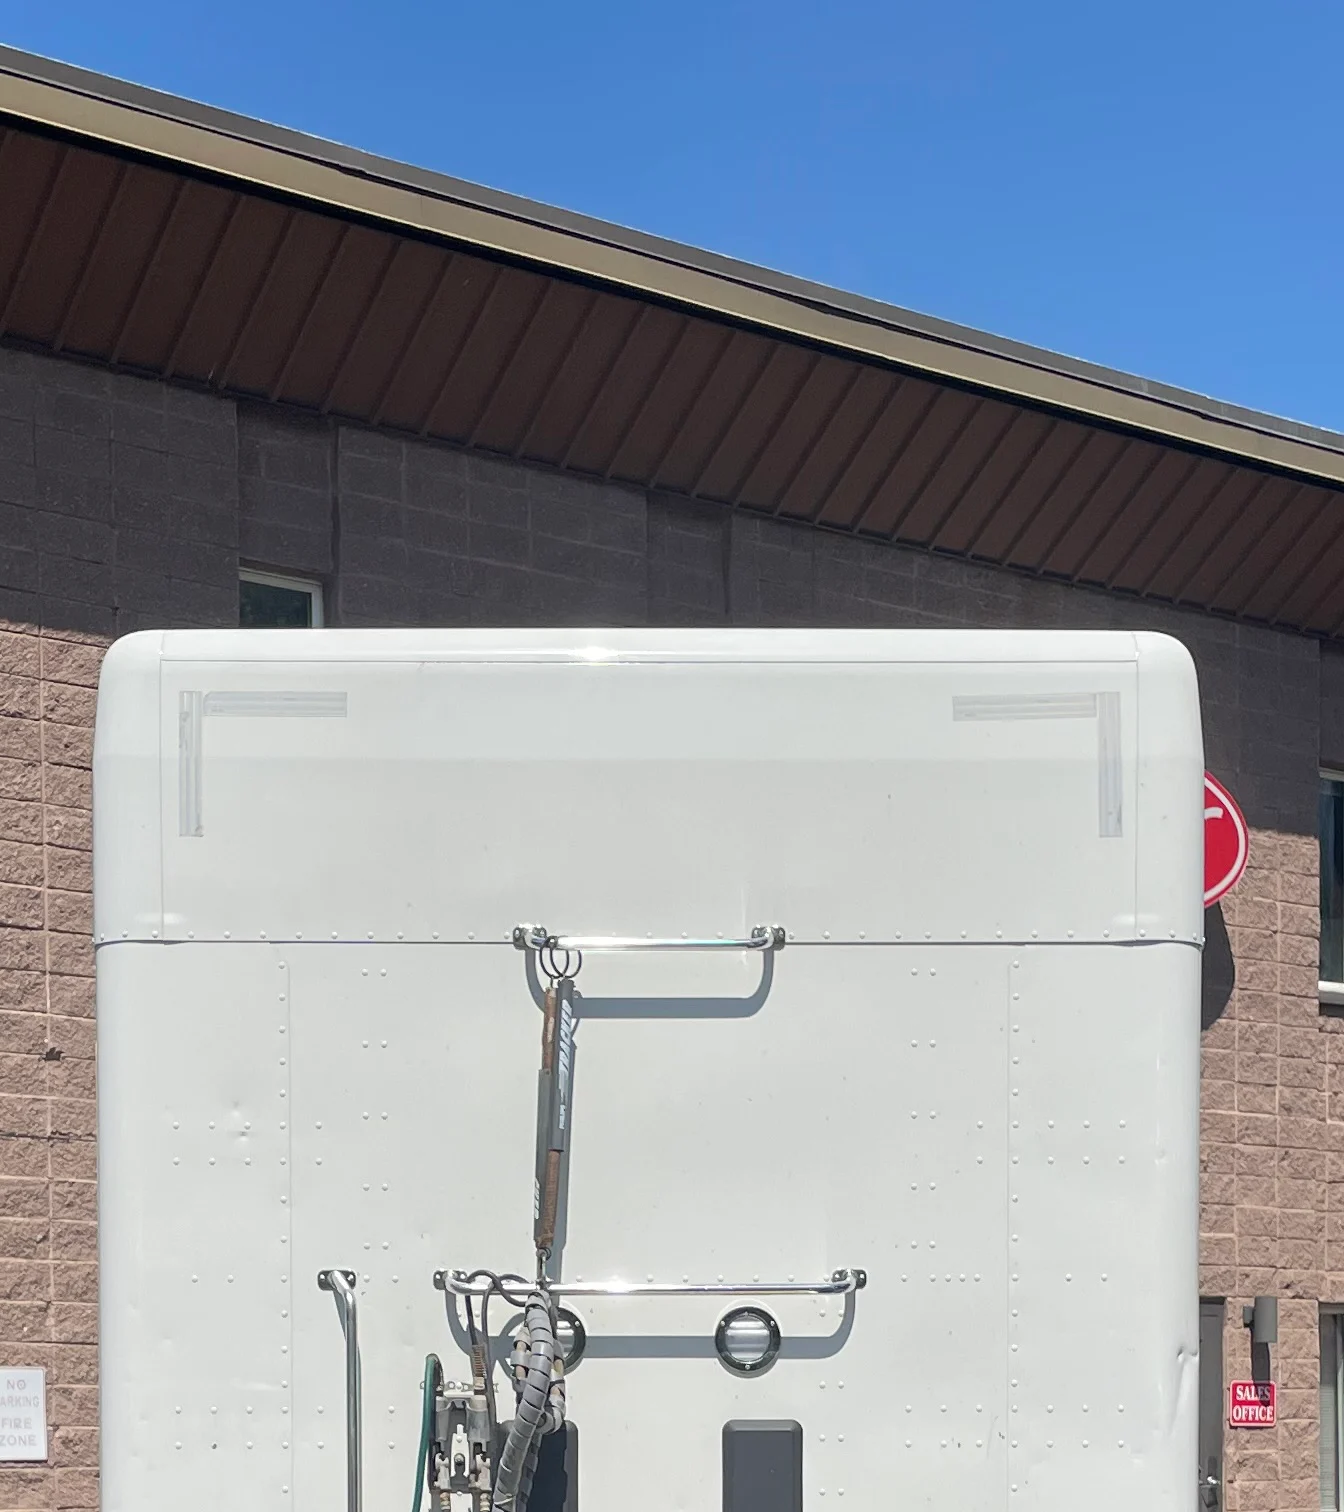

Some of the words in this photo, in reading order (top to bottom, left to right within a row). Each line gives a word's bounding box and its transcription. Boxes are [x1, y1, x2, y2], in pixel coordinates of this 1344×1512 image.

[6, 1379, 27, 1391] NO
[1236, 1385, 1271, 1401] SALES
[1232, 1405, 1274, 1422] OFFICE
[1, 1417, 33, 1430] FIRE
